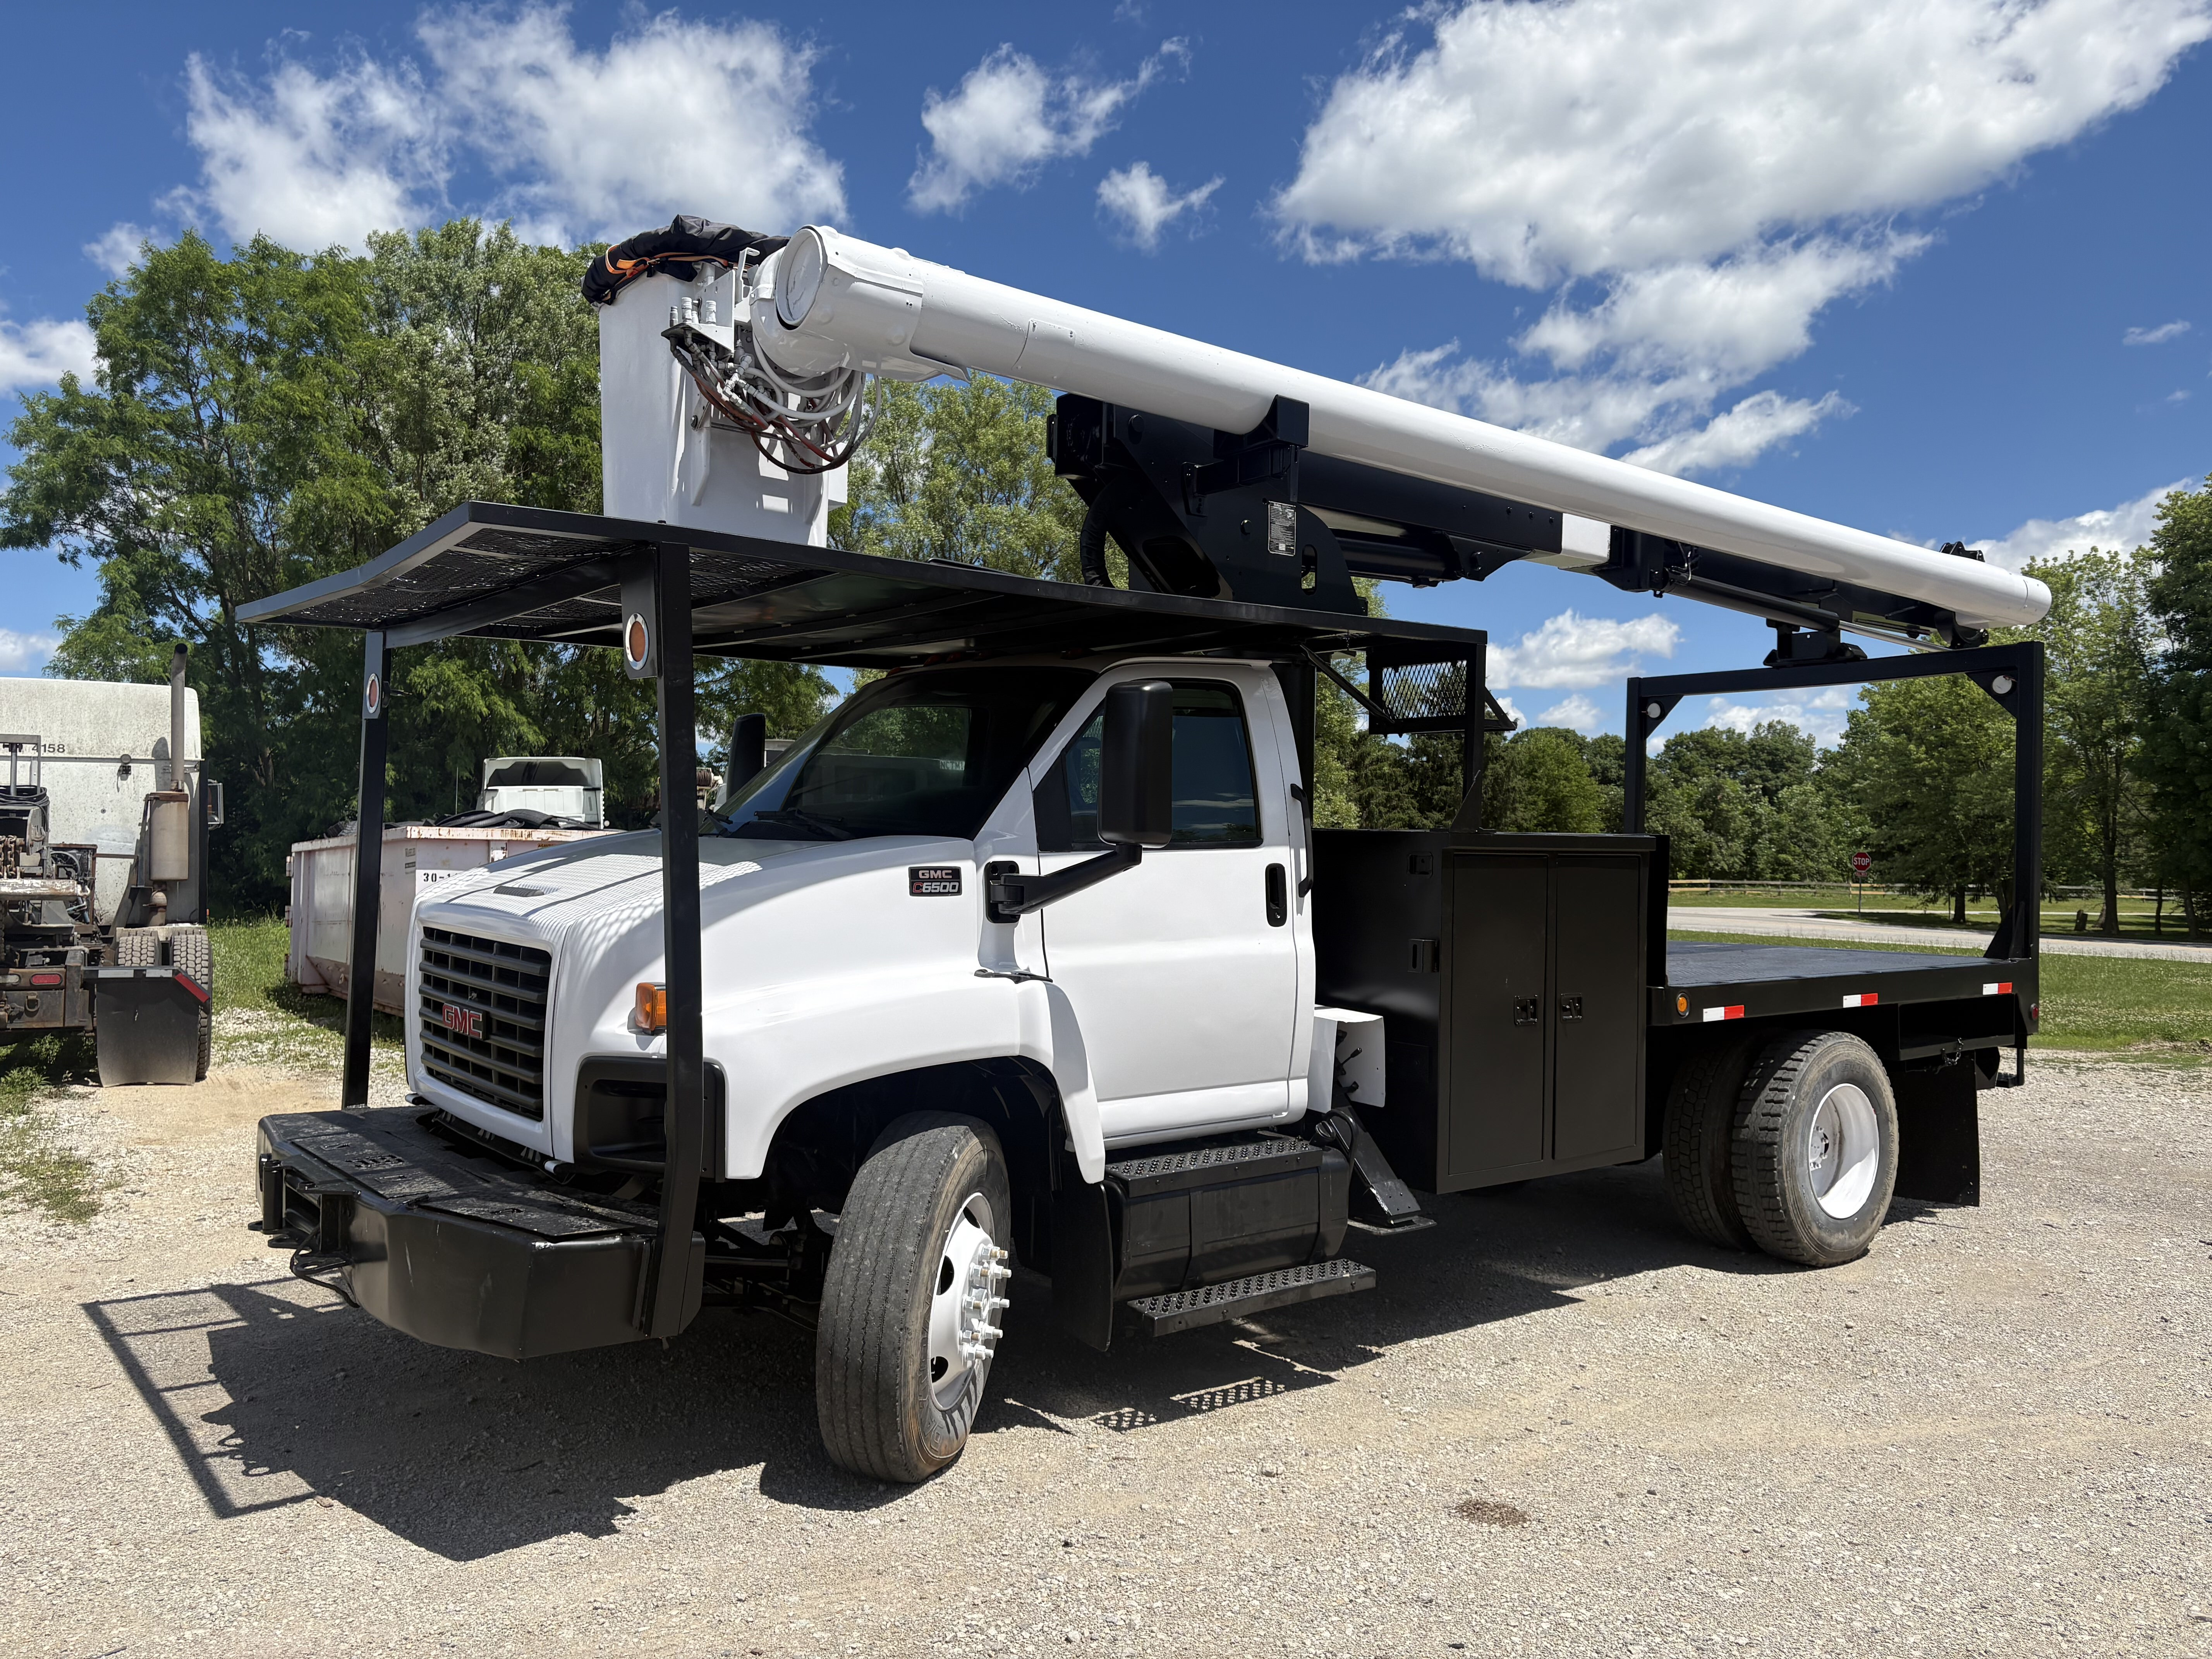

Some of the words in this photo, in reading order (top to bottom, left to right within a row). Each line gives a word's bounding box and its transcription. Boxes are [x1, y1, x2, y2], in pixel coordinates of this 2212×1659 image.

[1853, 857, 1870, 866] STOP
[919, 870, 952, 879] GMC
[913, 882, 959, 893] C6500
[443, 1003, 482, 1039] GMC
